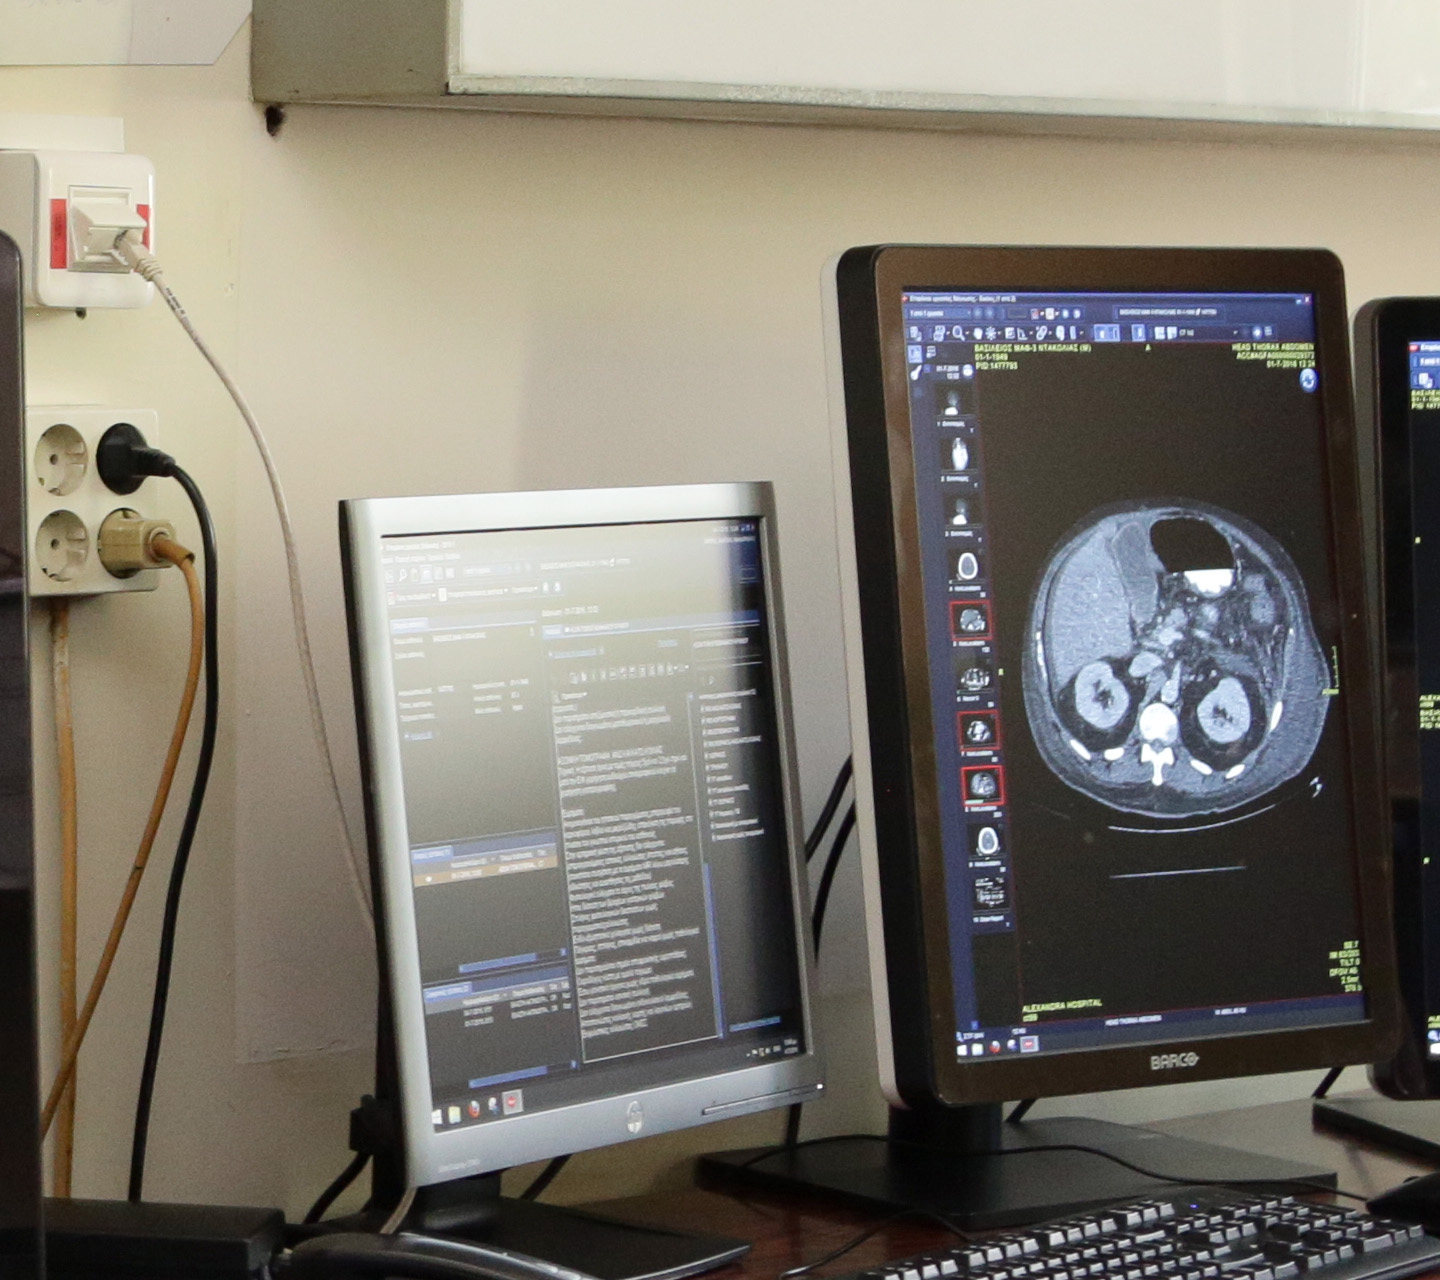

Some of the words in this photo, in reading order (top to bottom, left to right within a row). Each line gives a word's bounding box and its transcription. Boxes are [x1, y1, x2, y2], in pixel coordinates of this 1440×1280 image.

[1022, 1000, 1066, 1013] ALEXANDRA
[1067, 998, 1102, 1009] HOSPITAL
[1150, 1051, 1200, 1071] BARCO
